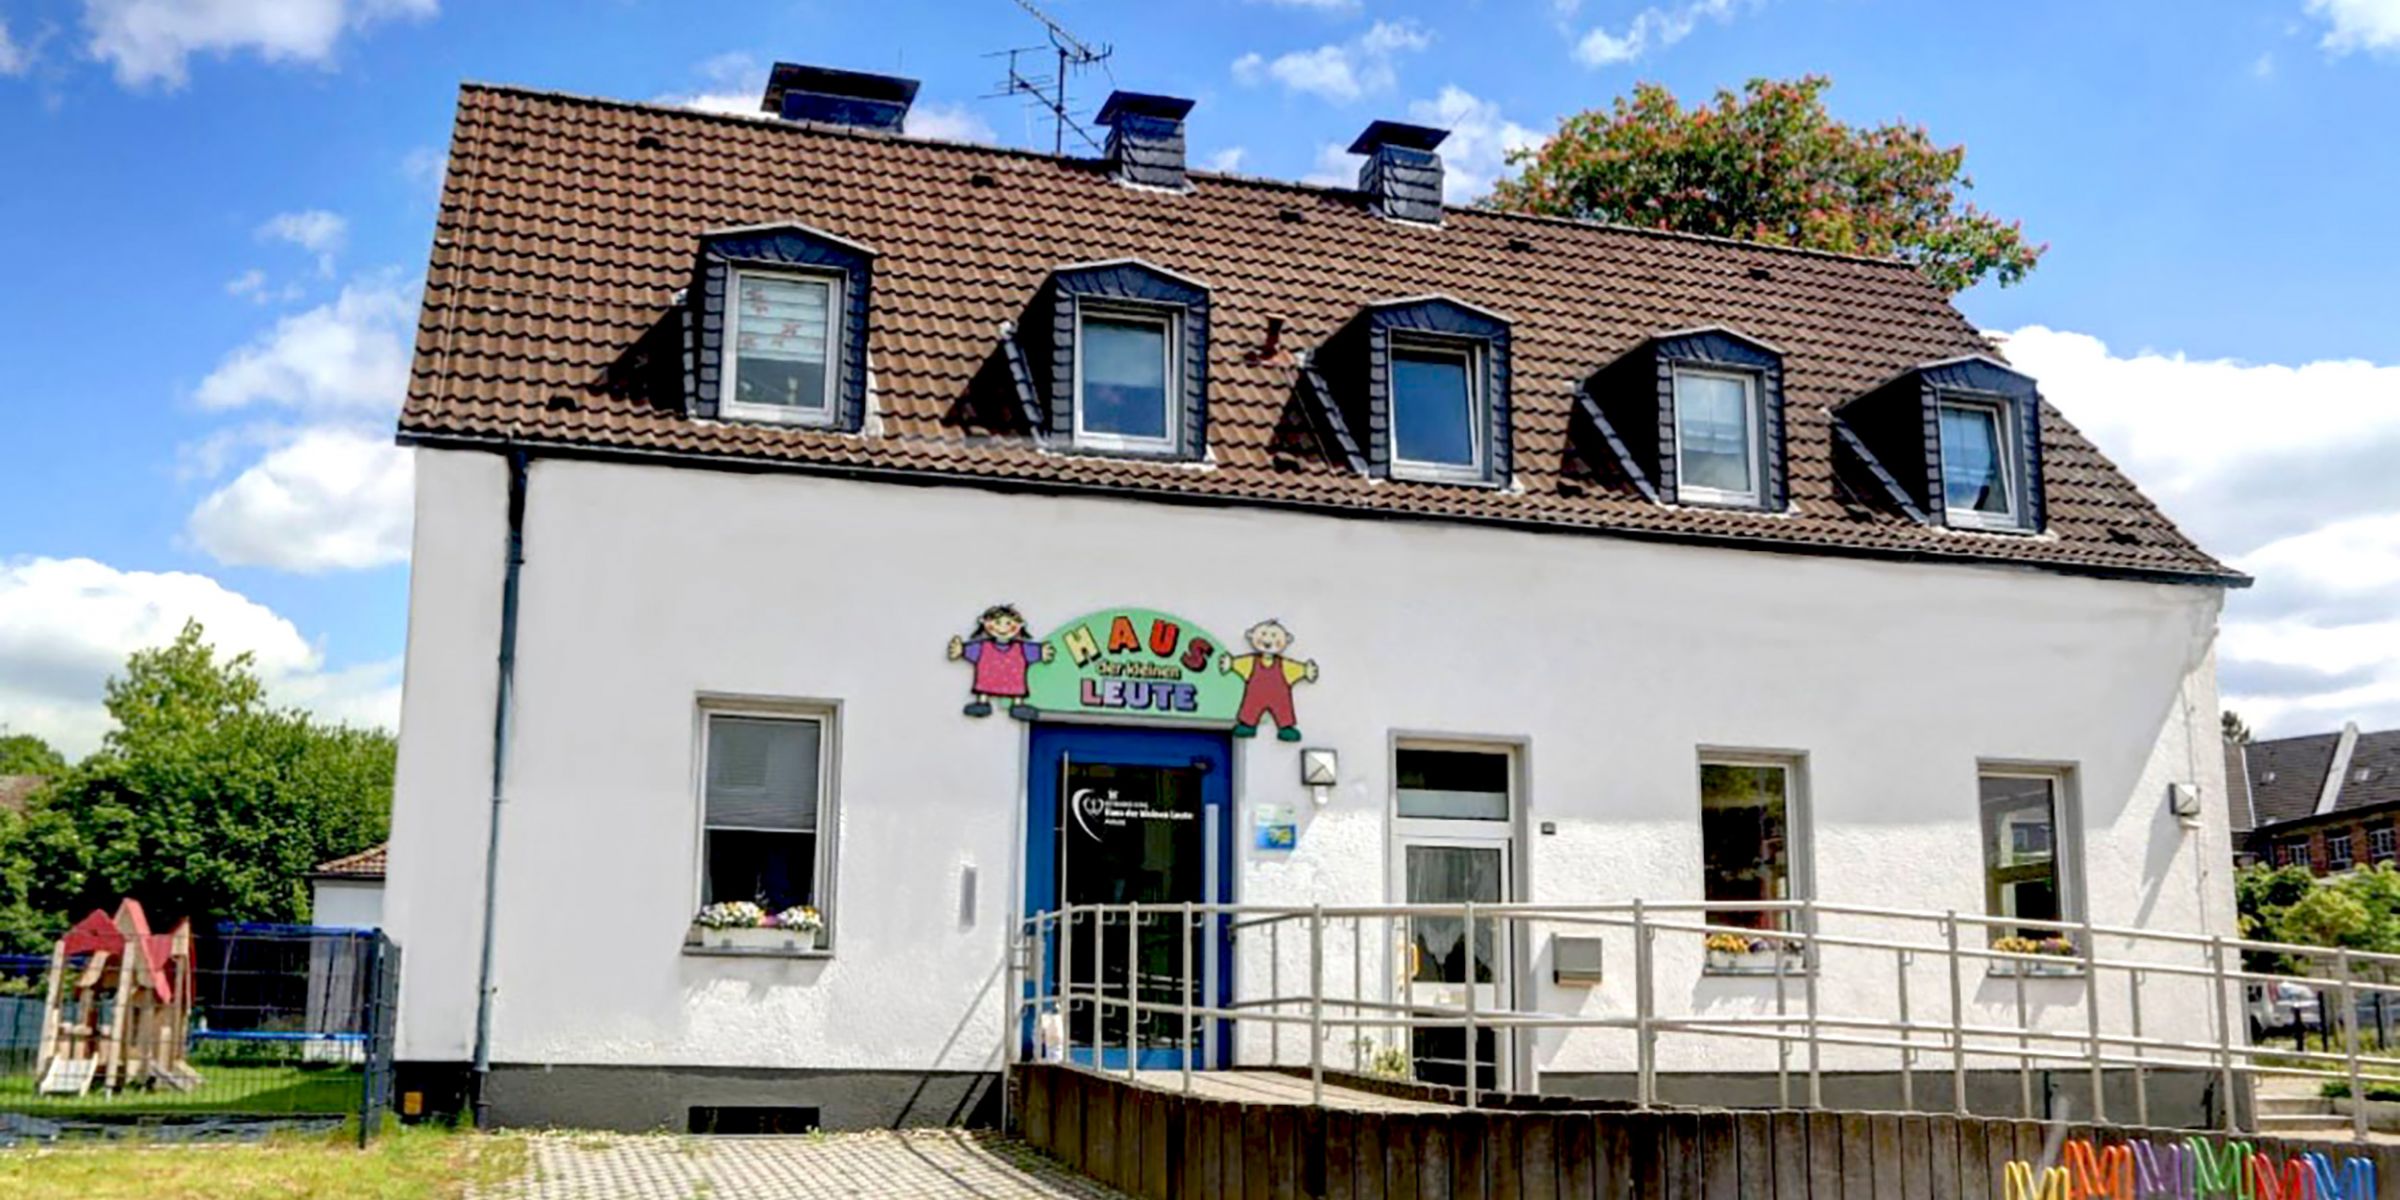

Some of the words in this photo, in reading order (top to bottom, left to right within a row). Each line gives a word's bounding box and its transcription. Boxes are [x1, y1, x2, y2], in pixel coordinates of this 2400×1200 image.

[1062, 615, 1214, 672] HAUS
[1097, 660, 1122, 676] der
[1126, 661, 1181, 679] kleinen
[1080, 678, 1198, 711] LEUTE
